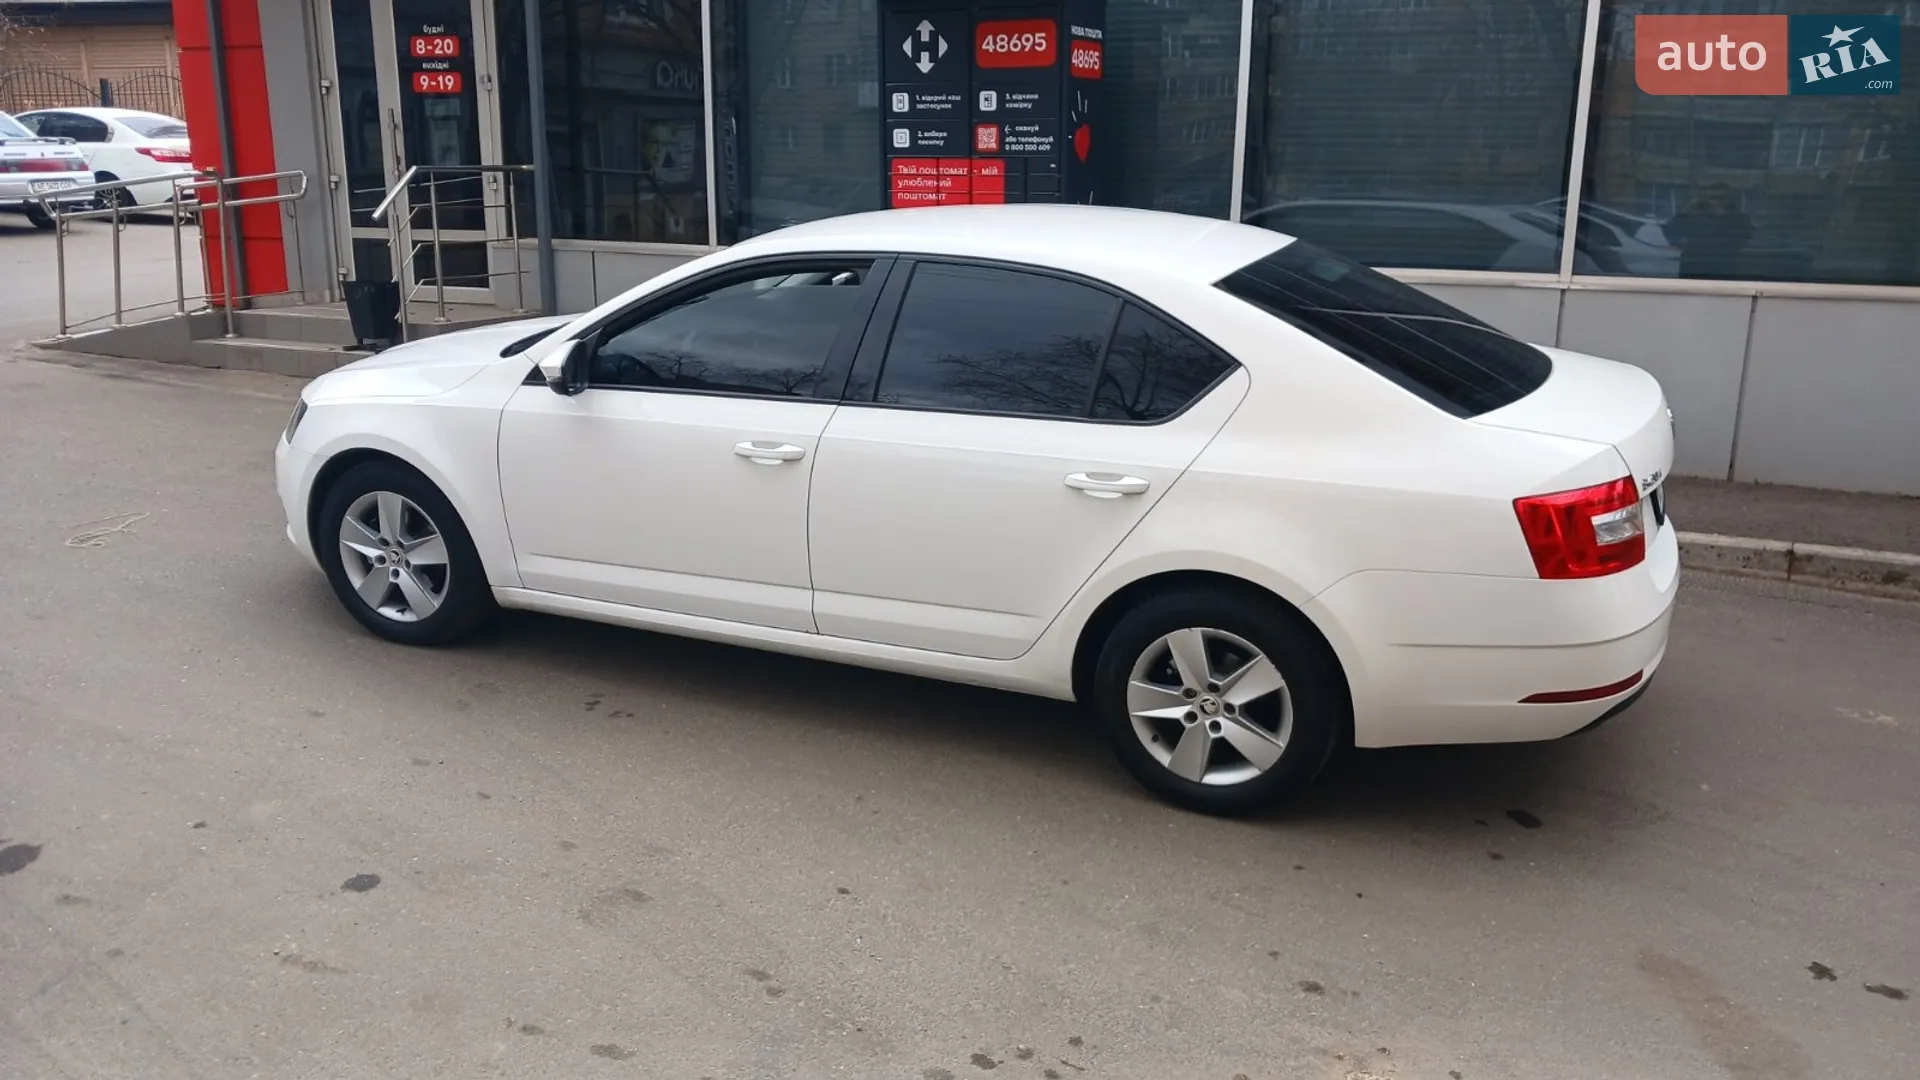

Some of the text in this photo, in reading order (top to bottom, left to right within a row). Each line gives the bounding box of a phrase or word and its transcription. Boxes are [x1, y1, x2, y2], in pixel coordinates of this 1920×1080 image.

[423, 24, 444, 34] будні
[416, 38, 453, 54] 8-20
[981, 32, 1047, 53] 48695
[422, 60, 449, 70] вихідні
[1071, 48, 1100, 70] 48695
[420, 75, 454, 90] 9-19
[897, 165, 916, 174] Твій
[981, 166, 998, 175] мій
